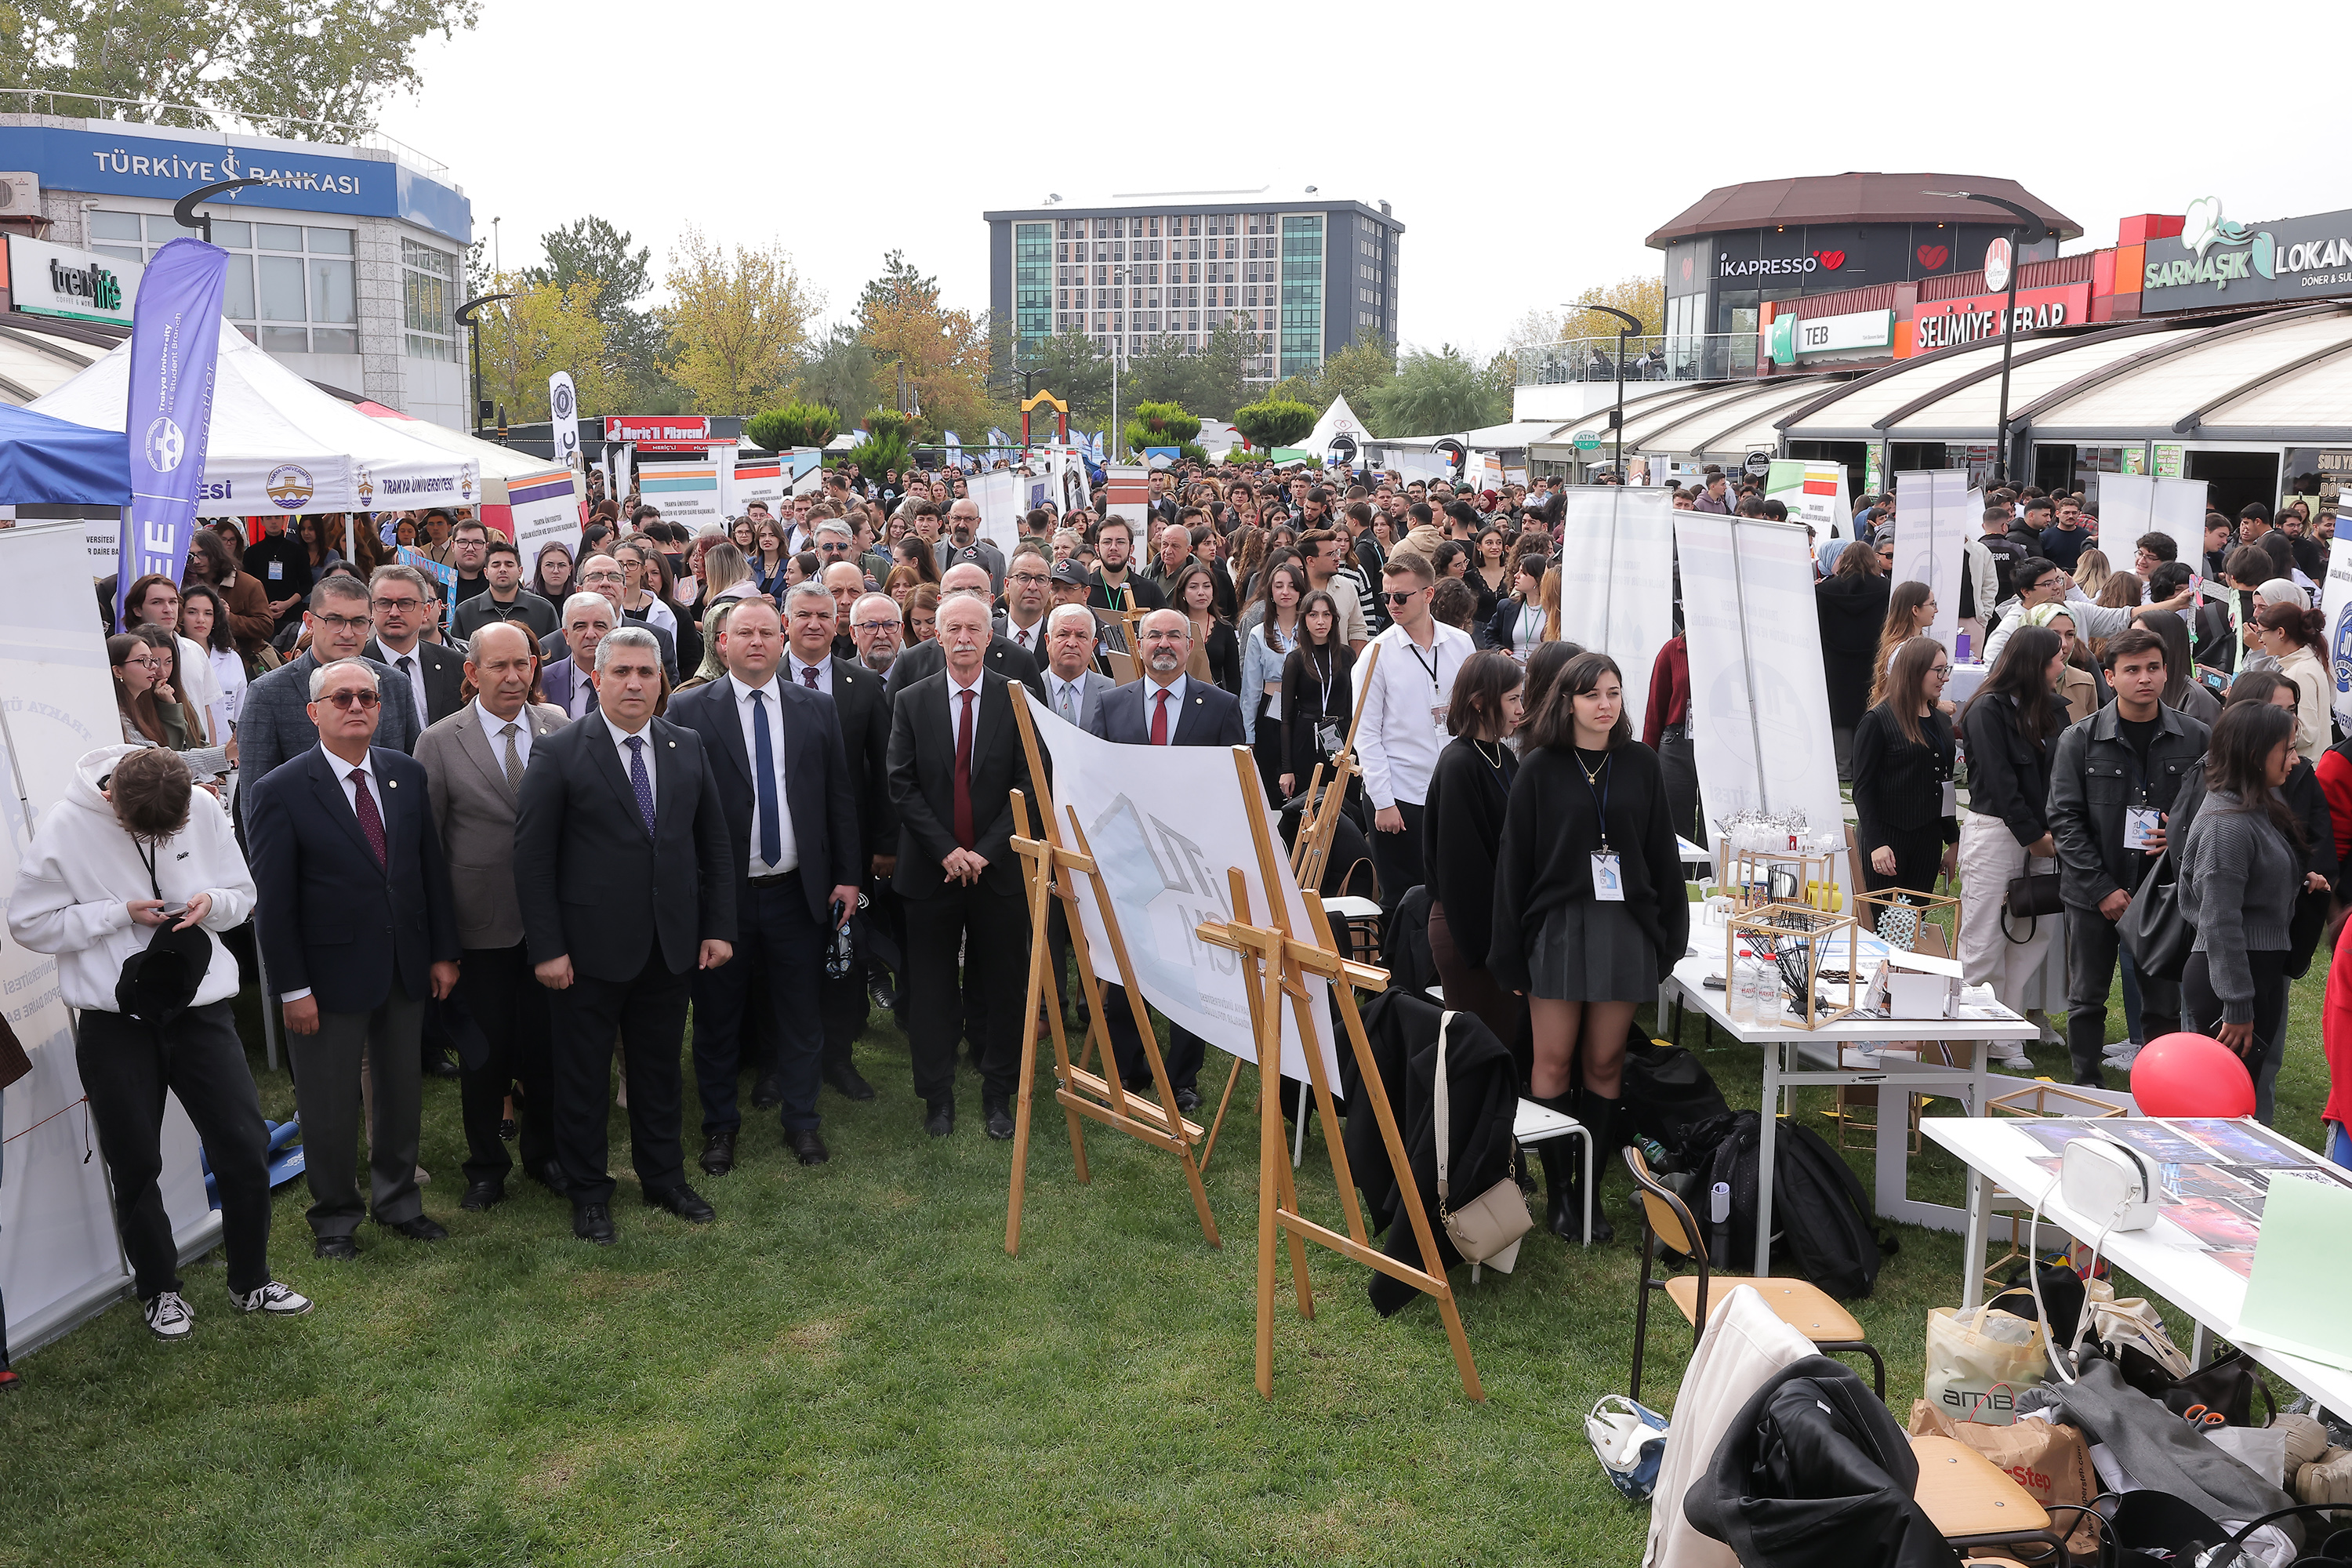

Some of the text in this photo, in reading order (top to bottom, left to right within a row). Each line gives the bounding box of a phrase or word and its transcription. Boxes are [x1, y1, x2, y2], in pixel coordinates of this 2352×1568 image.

[93, 147, 216, 183] TÜRKİYE
[249, 166, 361, 195] BANKASI
[2144, 250, 2252, 291] SARMAŞIK
[2301, 273, 2329, 287] DÖNER
[2330, 274, 2337, 284] &
[56, 296, 74, 305] COFFEE
[172, 312, 182, 350] Branch
[1806, 326, 1828, 346] TEB
[158, 323, 173, 412] Trakya University
[169, 351, 179, 394] Student
[2318, 455, 2341, 470] SULU
[382, 475, 456, 494] TRAKYA ÜNİVERSİTESİ
[93, 546, 110, 555] DAİRE
